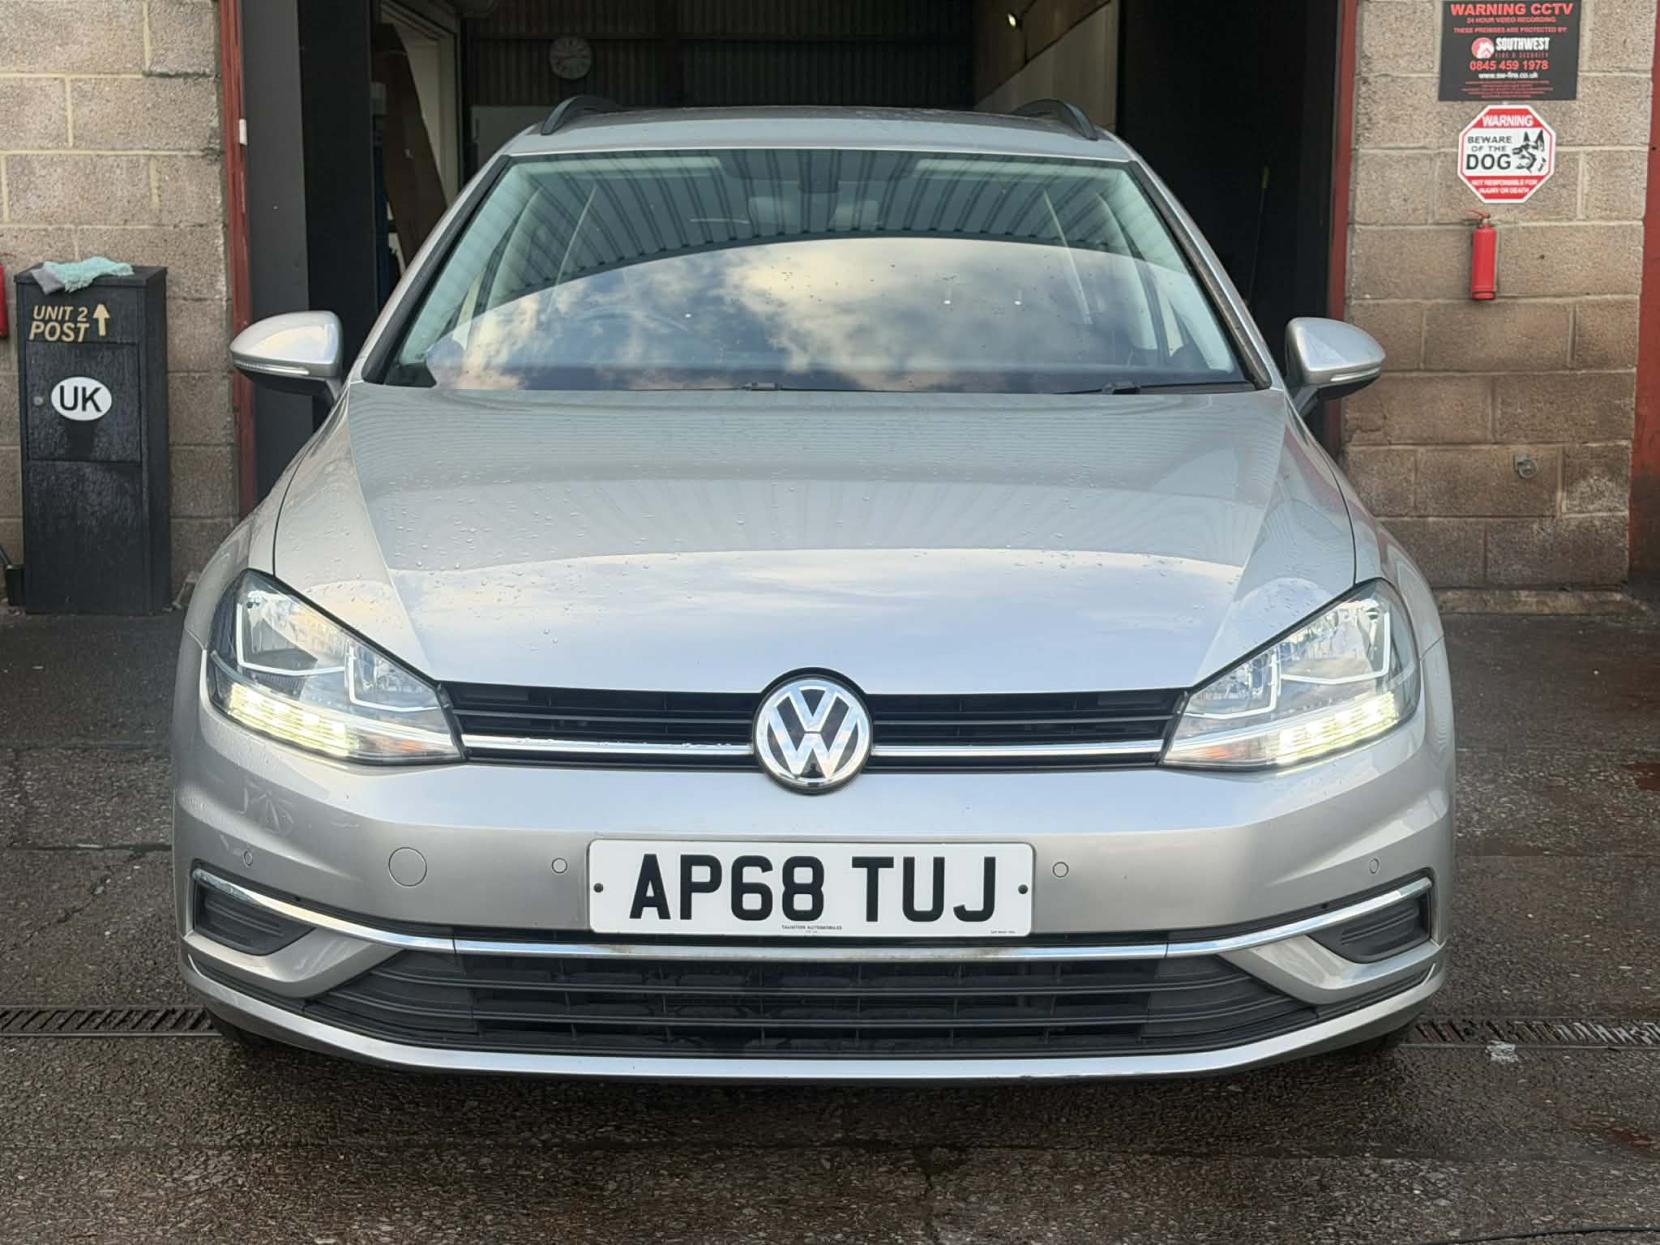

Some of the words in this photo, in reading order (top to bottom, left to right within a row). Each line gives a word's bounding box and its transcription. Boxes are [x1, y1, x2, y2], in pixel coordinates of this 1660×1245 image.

[1450, 3, 1526, 16] WARNING
[1531, 3, 1573, 15] CCTV
[1495, 37, 1550, 51] SOUTHWEST
[1469, 60, 1497, 71] 0845
[1499, 60, 1520, 71] 459
[1522, 60, 1549, 70] 1978
[1481, 115, 1534, 127] WARNING
[1467, 136, 1512, 144] BEWARE
[1466, 154, 1511, 170] DOG
[33, 305, 74, 320] UNIT
[77, 307, 88, 322] 2
[29, 321, 90, 342] POST
[59, 385, 102, 413] UK
[629, 853, 825, 922] AP68
[851, 856, 997, 923] TUJ
